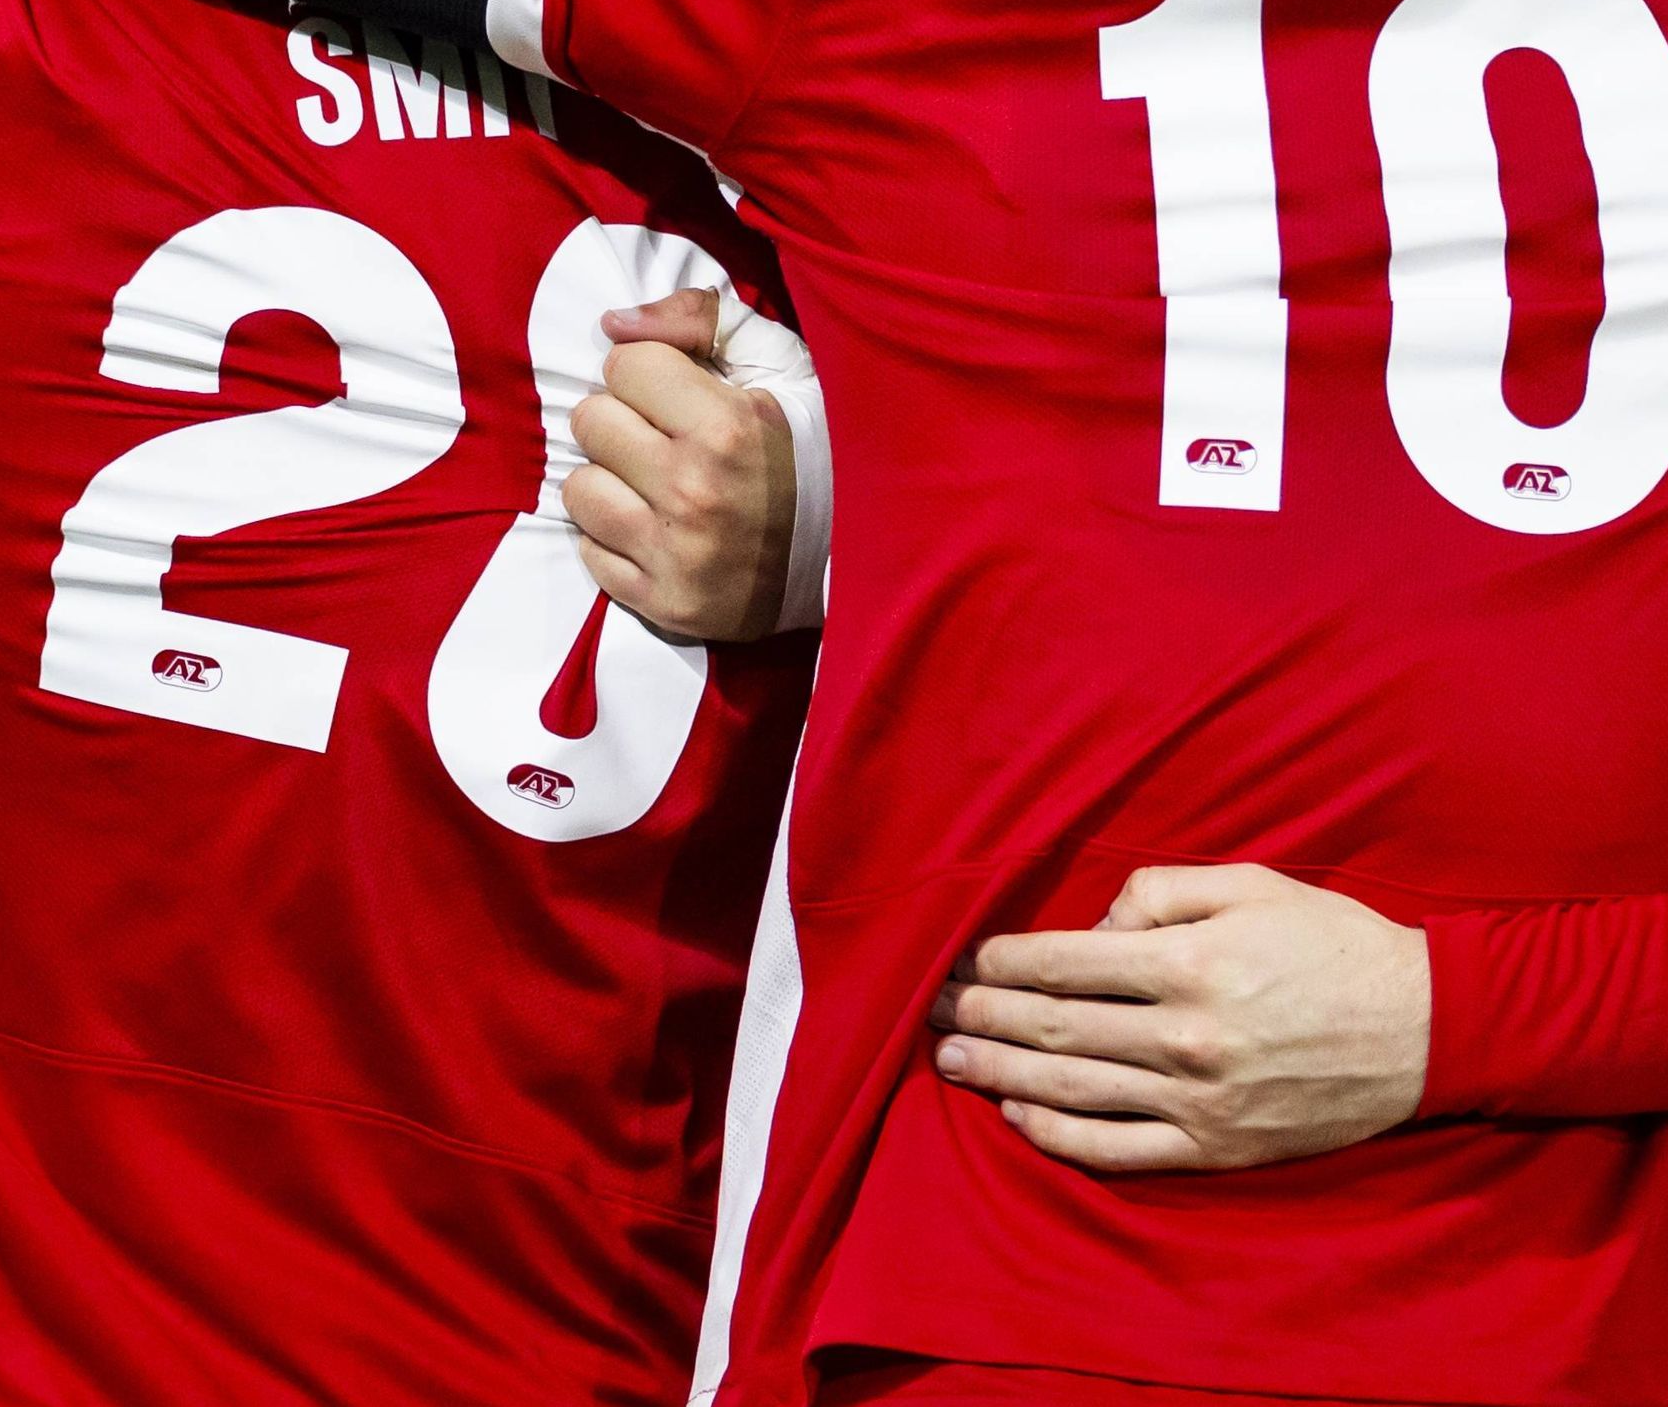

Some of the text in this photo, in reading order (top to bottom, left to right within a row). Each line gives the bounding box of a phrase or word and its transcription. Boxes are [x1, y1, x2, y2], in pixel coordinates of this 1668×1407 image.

[1198, 443, 1244, 470] AZ
[1514, 468, 1561, 497] AZ
[162, 655, 209, 688] AZ
[515, 772, 561, 805] AZ
